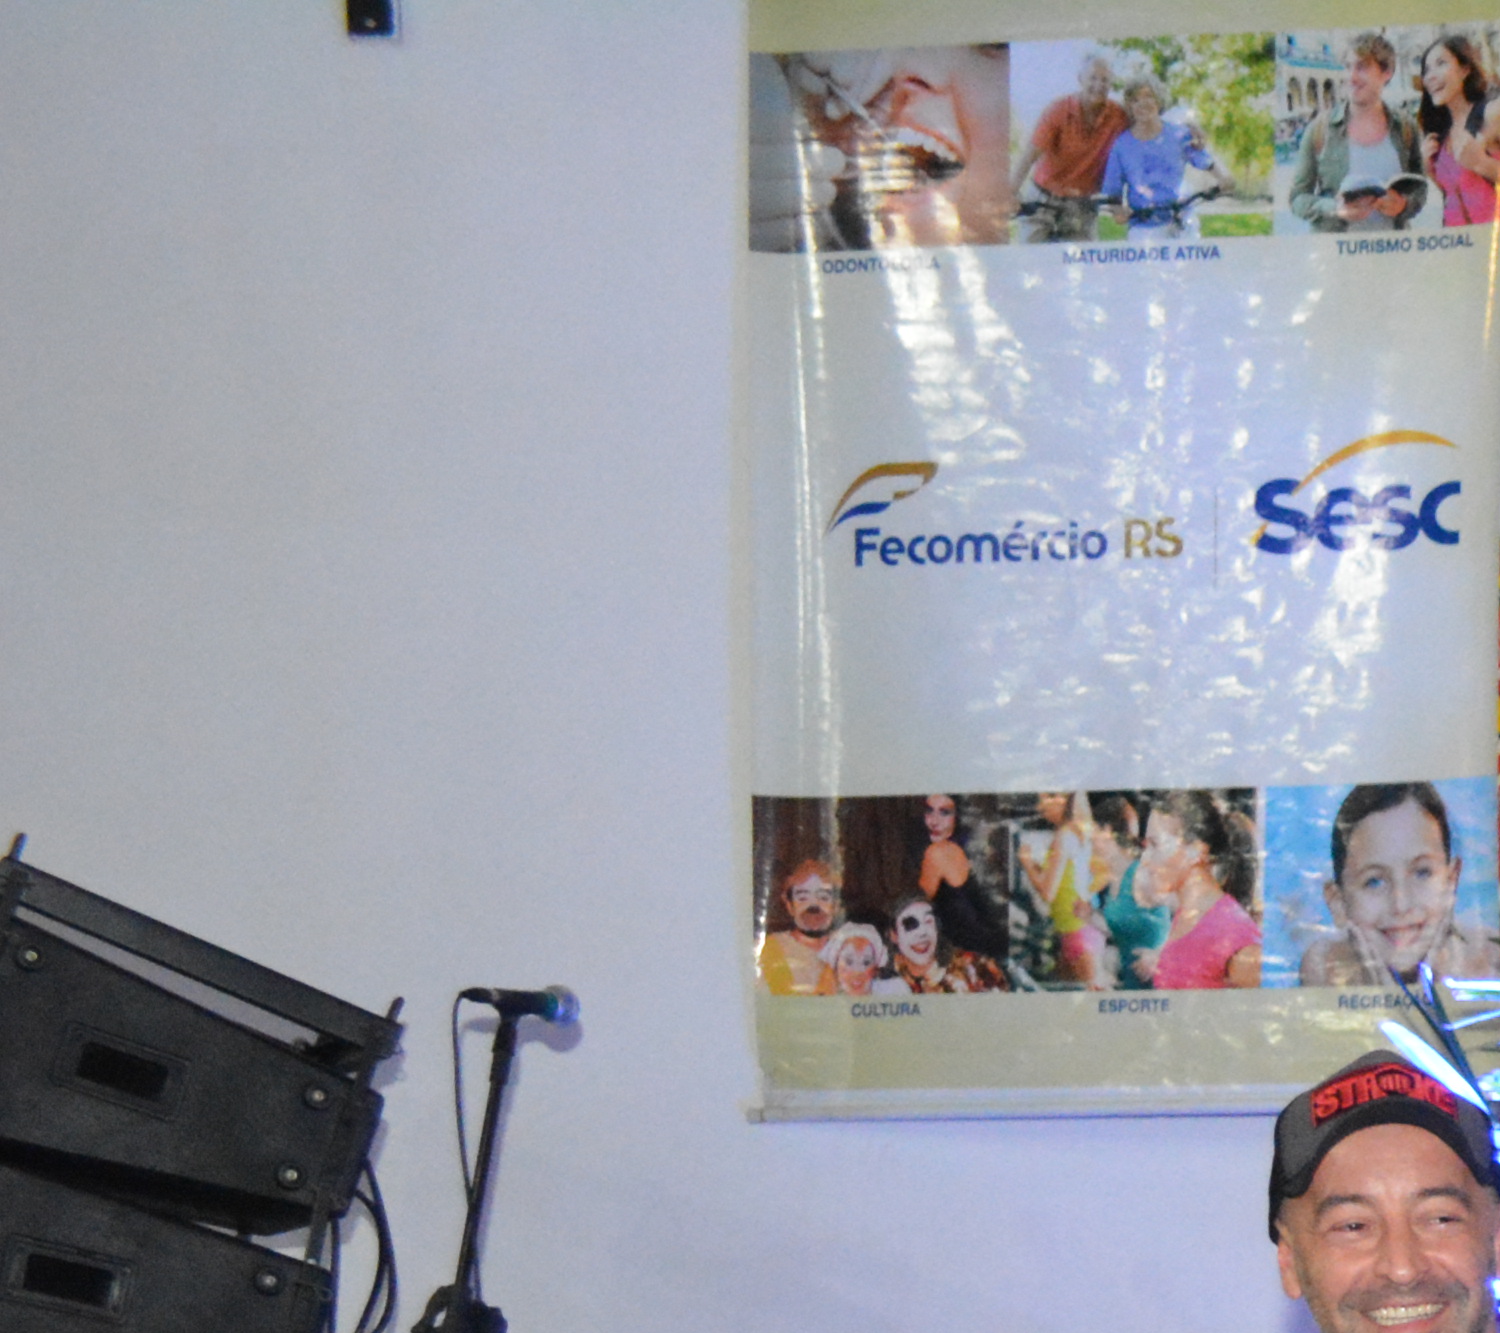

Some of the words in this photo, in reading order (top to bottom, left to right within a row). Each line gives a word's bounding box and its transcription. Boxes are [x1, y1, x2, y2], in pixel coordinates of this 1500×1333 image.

[1336, 238, 1412, 255] TURISMO
[1417, 233, 1474, 250] SOCIAL
[1063, 246, 1170, 264] MATURIDADE
[1175, 245, 1221, 260] ATIVA
[853, 520, 1108, 567] Fecomércio
[1123, 517, 1185, 560] RS
[851, 1002, 921, 1018] CULTURA
[1098, 998, 1170, 1014] ESPORTE
